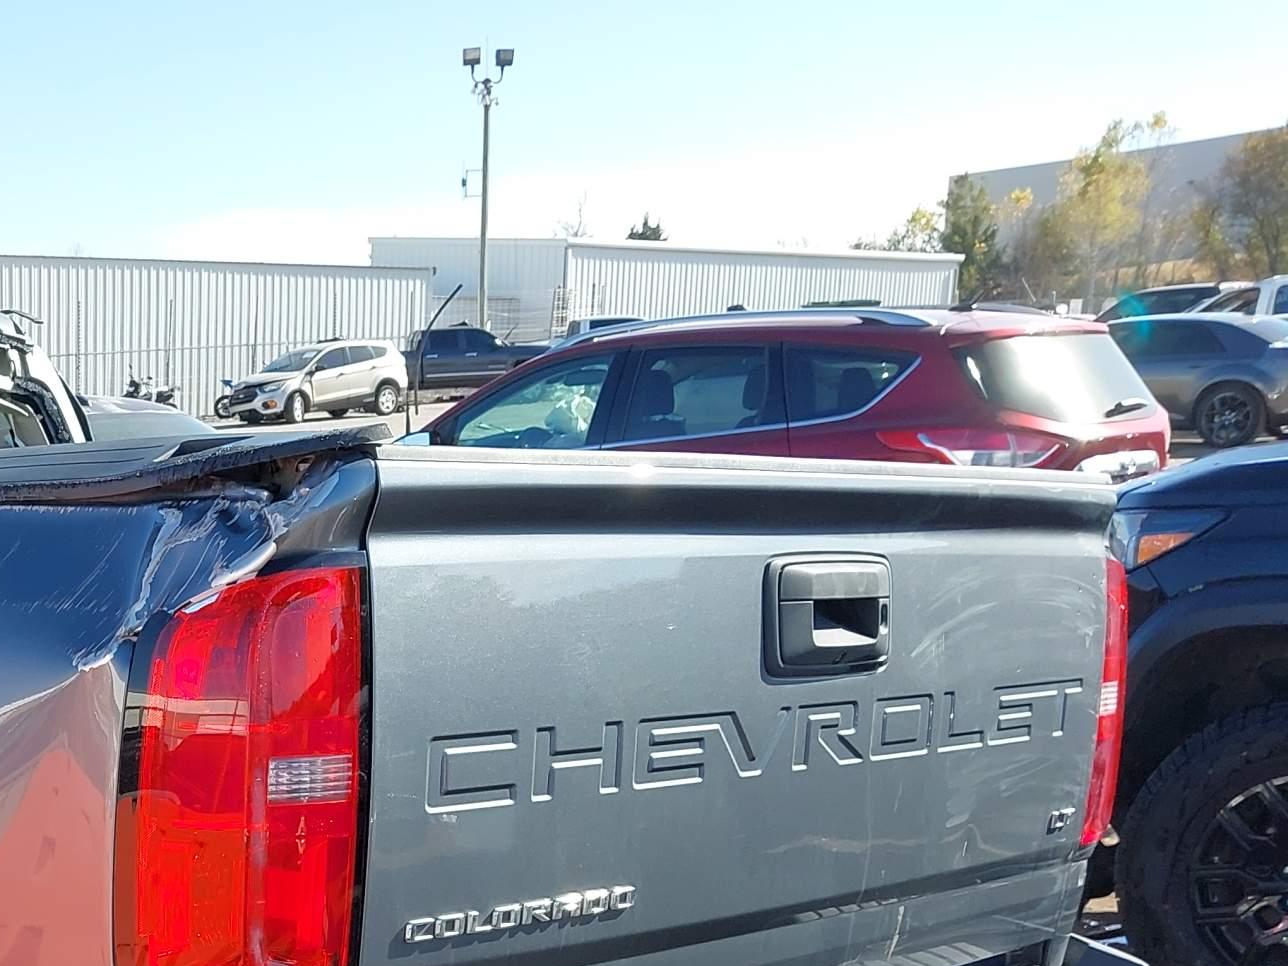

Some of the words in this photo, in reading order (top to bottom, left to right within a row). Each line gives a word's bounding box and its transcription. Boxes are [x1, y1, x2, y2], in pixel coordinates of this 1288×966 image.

[425, 678, 1083, 814] CHEVROLET
[1050, 807, 1077, 829] LT
[404, 885, 636, 944] COLORADO
